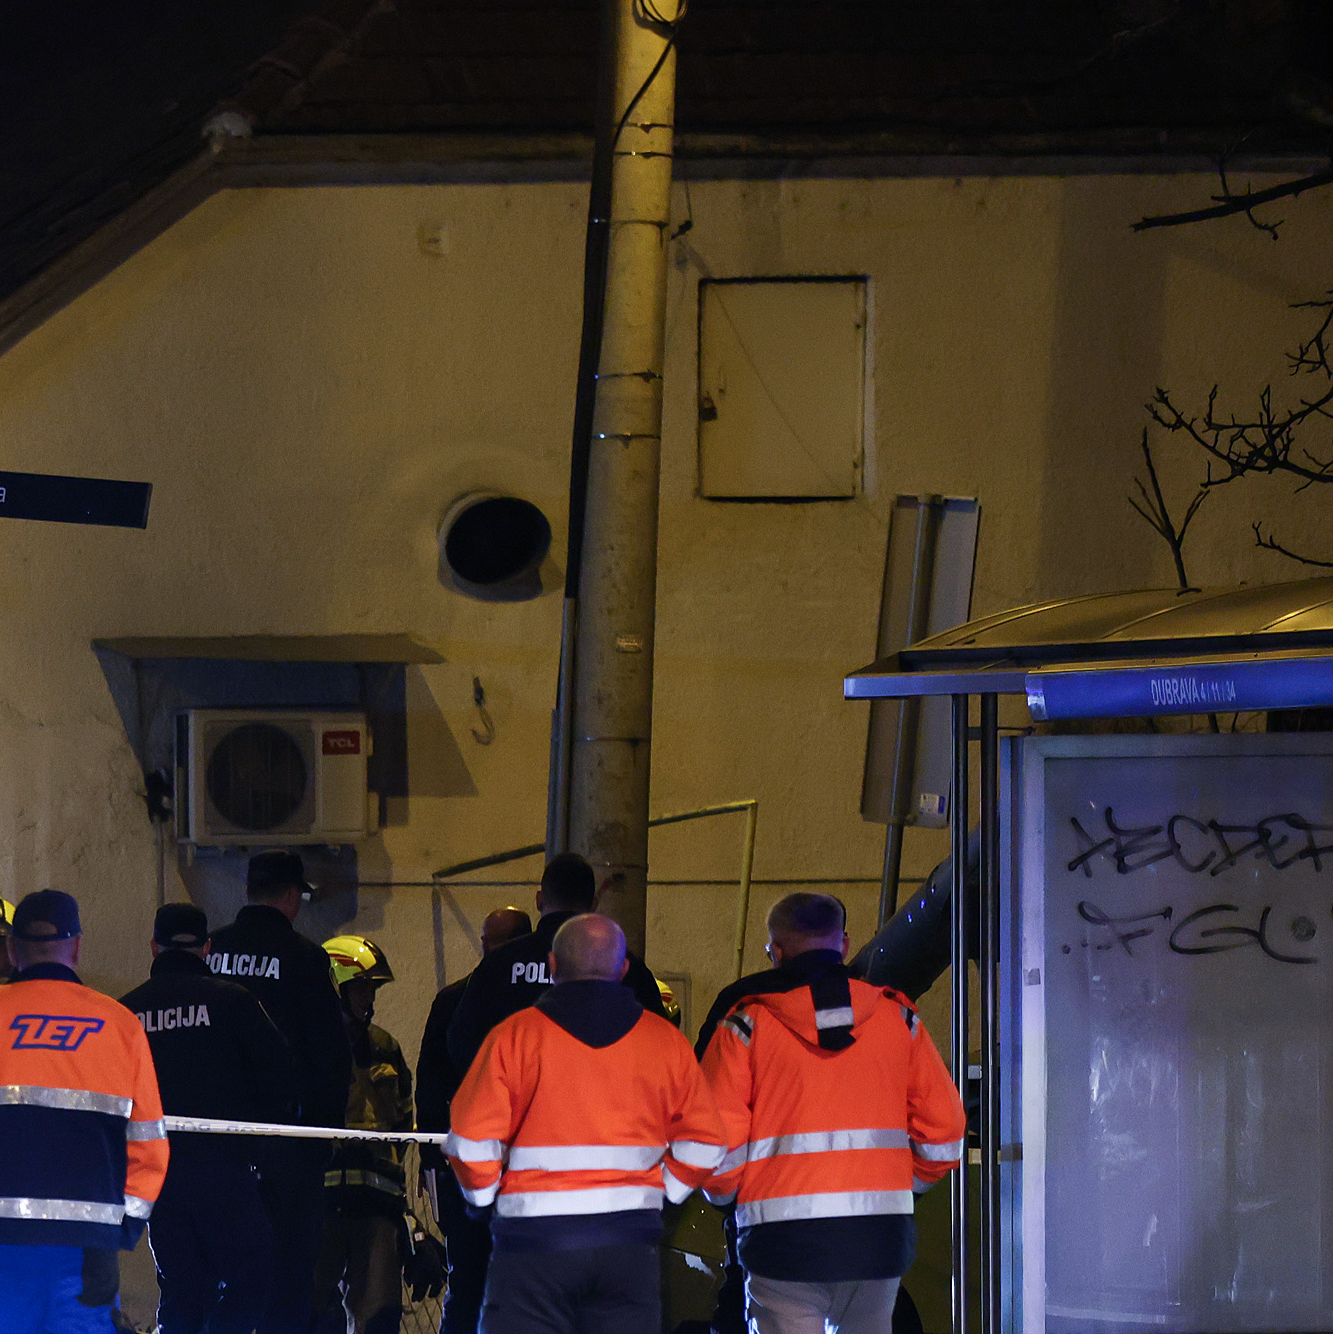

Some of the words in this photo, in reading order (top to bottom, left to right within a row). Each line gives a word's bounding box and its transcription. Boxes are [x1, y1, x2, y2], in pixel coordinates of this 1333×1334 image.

[1151, 677, 1199, 706] DUBRAVA
[328, 738, 355, 748] TCL
[9, 1014, 106, 1051] ZET
[136, 1004, 210, 1033] OLICIJA
